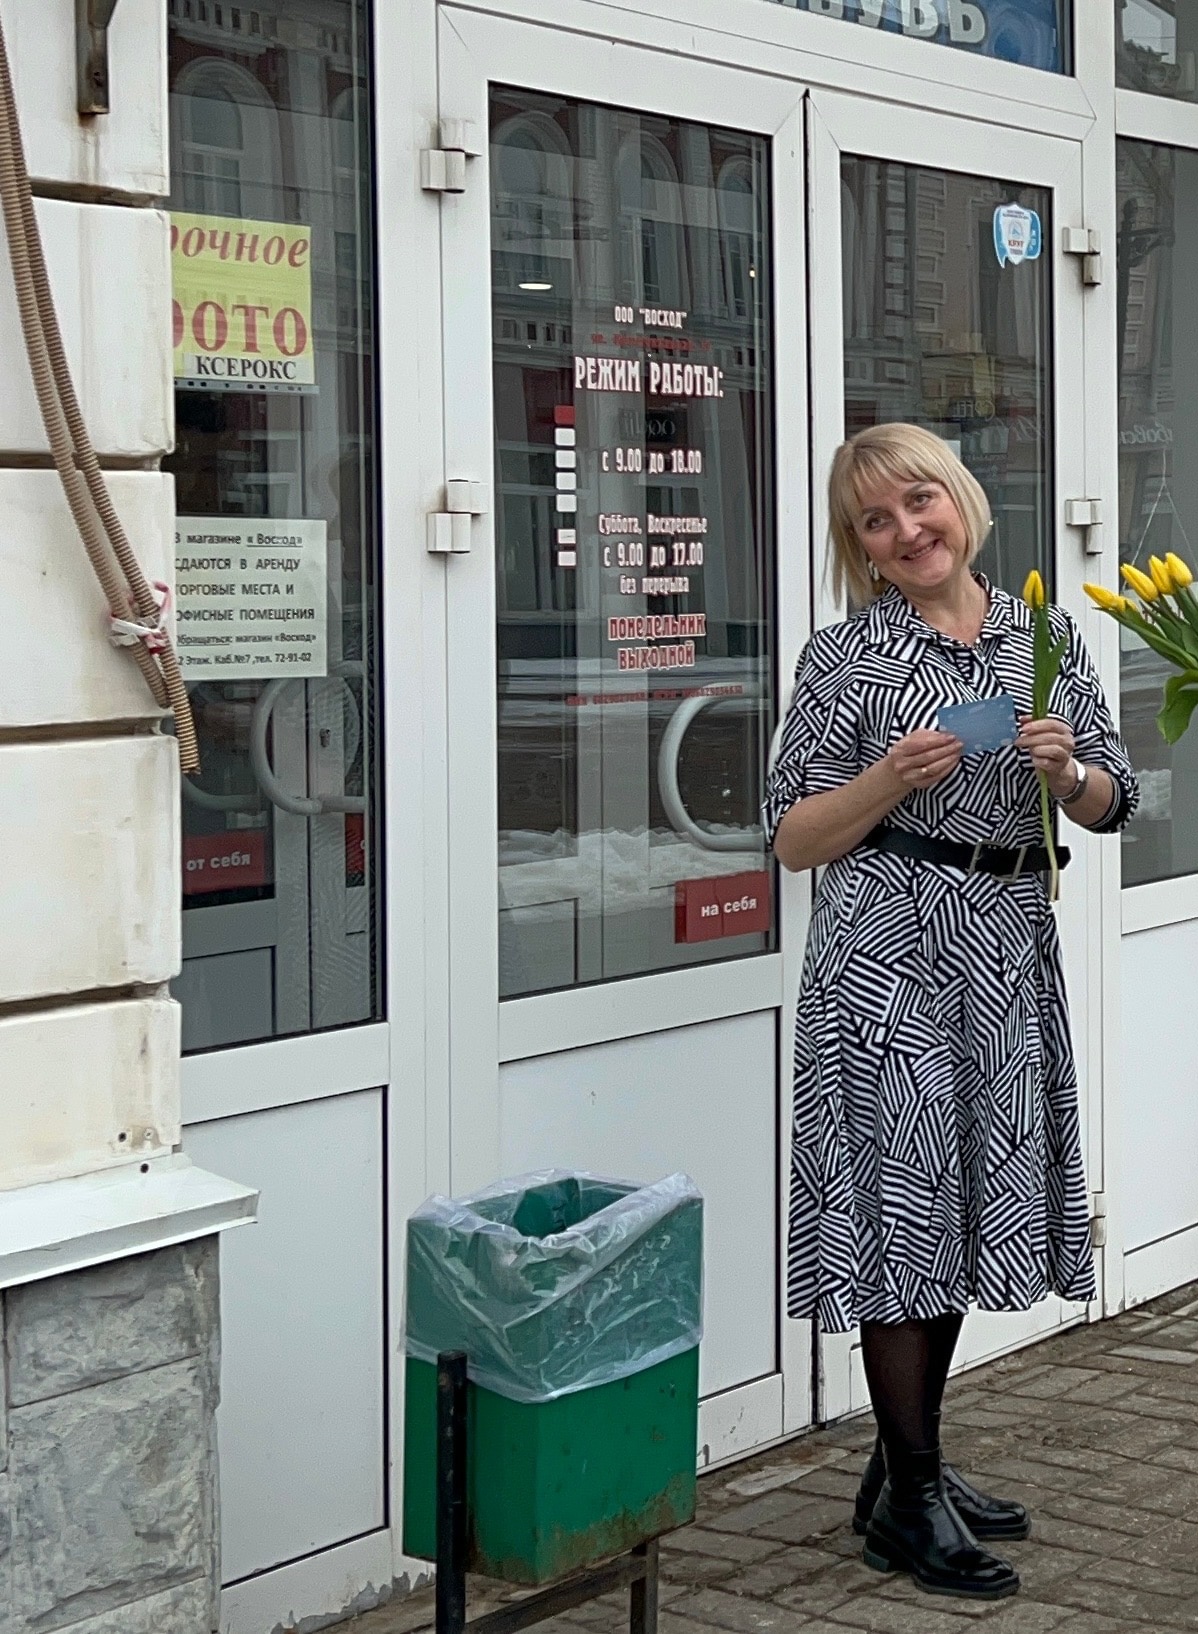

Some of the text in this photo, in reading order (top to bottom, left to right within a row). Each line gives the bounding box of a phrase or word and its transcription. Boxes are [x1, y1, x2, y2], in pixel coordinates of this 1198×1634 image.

[614, 306, 687, 329] ООО "ВОСХОД"
[195, 354, 297, 380] КСЕРОКС
[574, 356, 724, 398] РЕЖИМ РАБОТЫ:
[616, 448, 642, 472] 9.00
[650, 452, 665, 474] до
[671, 450, 702, 473] 18.00
[598, 514, 708, 535] Суббота, Воскресенье
[187, 535, 241, 545] магазине
[240, 558, 248, 570] В
[256, 558, 301, 572] АРЕНДУ
[617, 542, 644, 567] 9.00
[650, 546, 666, 568] до
[672, 542, 704, 567] 17.00
[241, 584, 281, 596] МЕСТА
[286, 584, 294, 595] И
[620, 574, 690, 595] без перерыва
[240, 609, 315, 622] ПОМЕЩЕНИЯ
[235, 635, 272, 643] магазин
[186, 851, 251, 871] от себя
[701, 895, 757, 917] на себя
